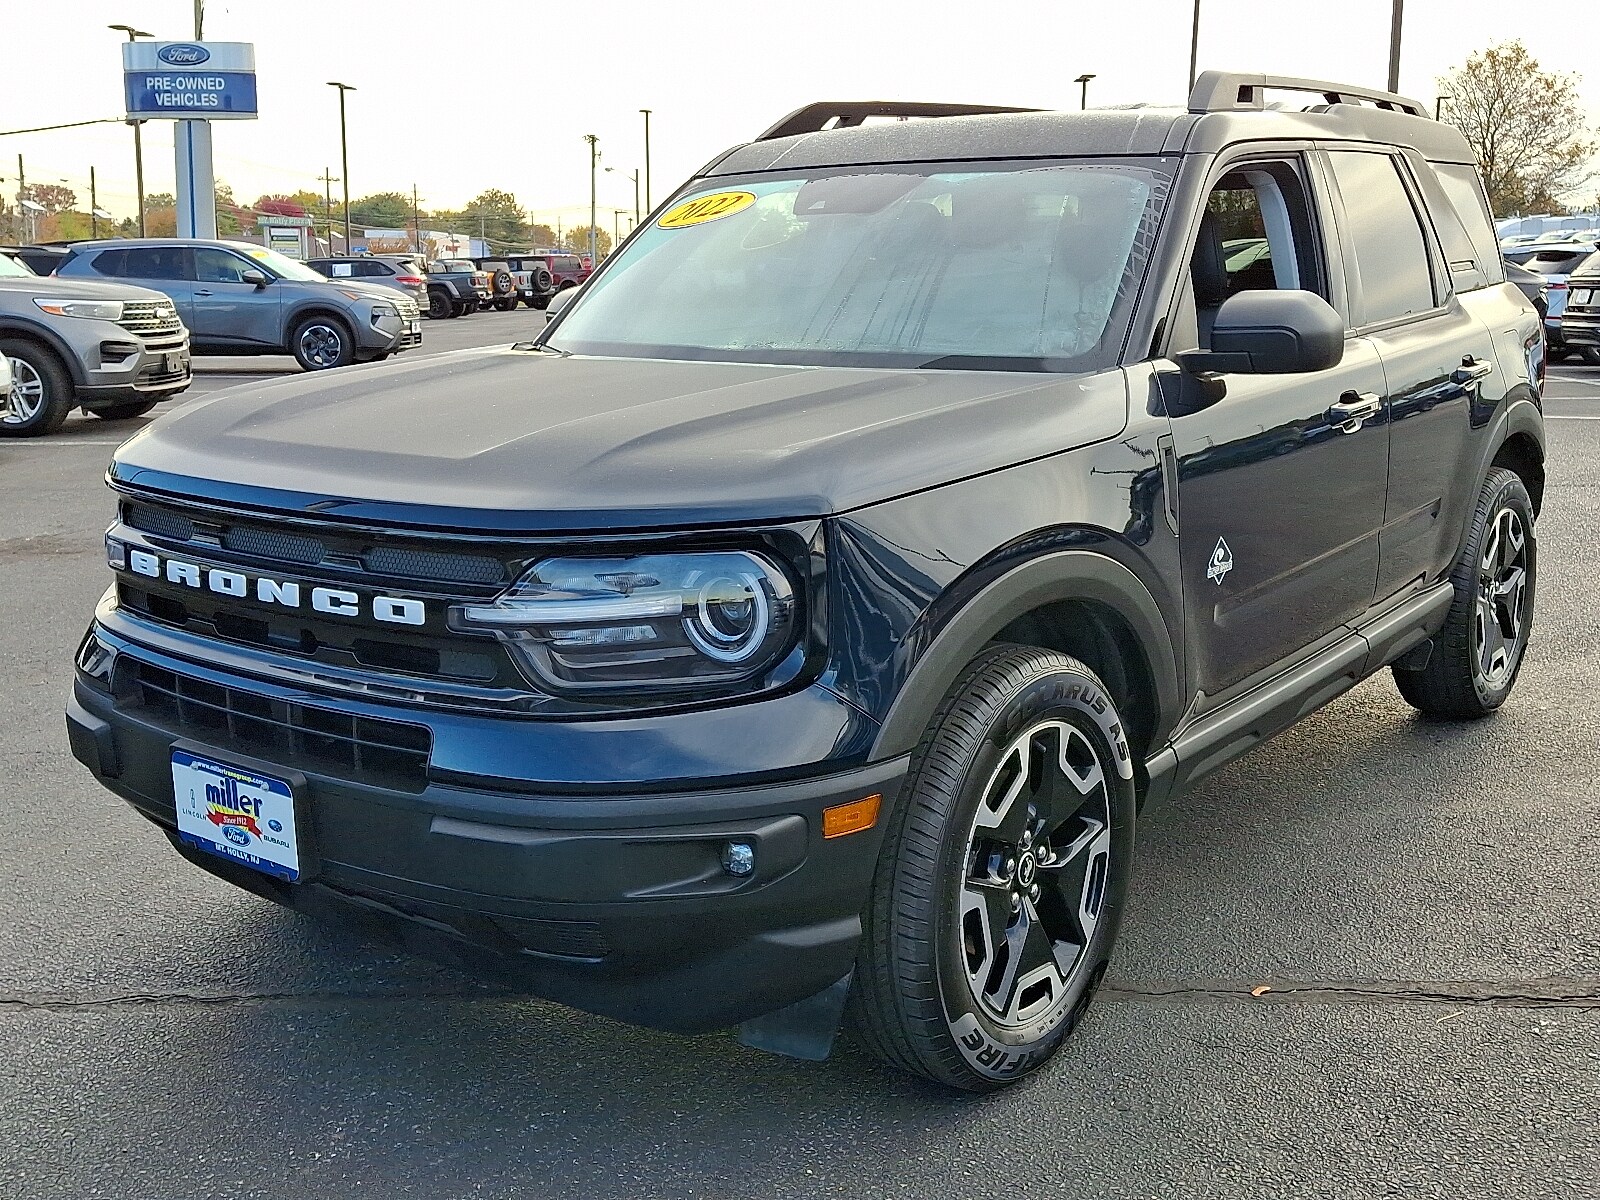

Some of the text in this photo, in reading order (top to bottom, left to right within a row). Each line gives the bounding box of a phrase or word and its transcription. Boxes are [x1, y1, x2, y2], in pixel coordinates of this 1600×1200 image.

[168, 47, 198, 62] Ford
[146, 77, 225, 90] PRE-OWNED
[155, 93, 218, 106] VEHICLES
[666, 195, 744, 224] 2022
[270, 216, 288, 226] Holly
[130, 549, 426, 626] BRONCO
[1109, 720, 1131, 762] AS
[205, 778, 263, 817] miller
[182, 808, 207, 821] LINCOLN
[222, 815, 247, 826] Since 1912
[227, 828, 245, 844] Ford
[263, 834, 290, 849] SUBARU
[215, 842, 260, 865] MT. HOLLY, NJ
